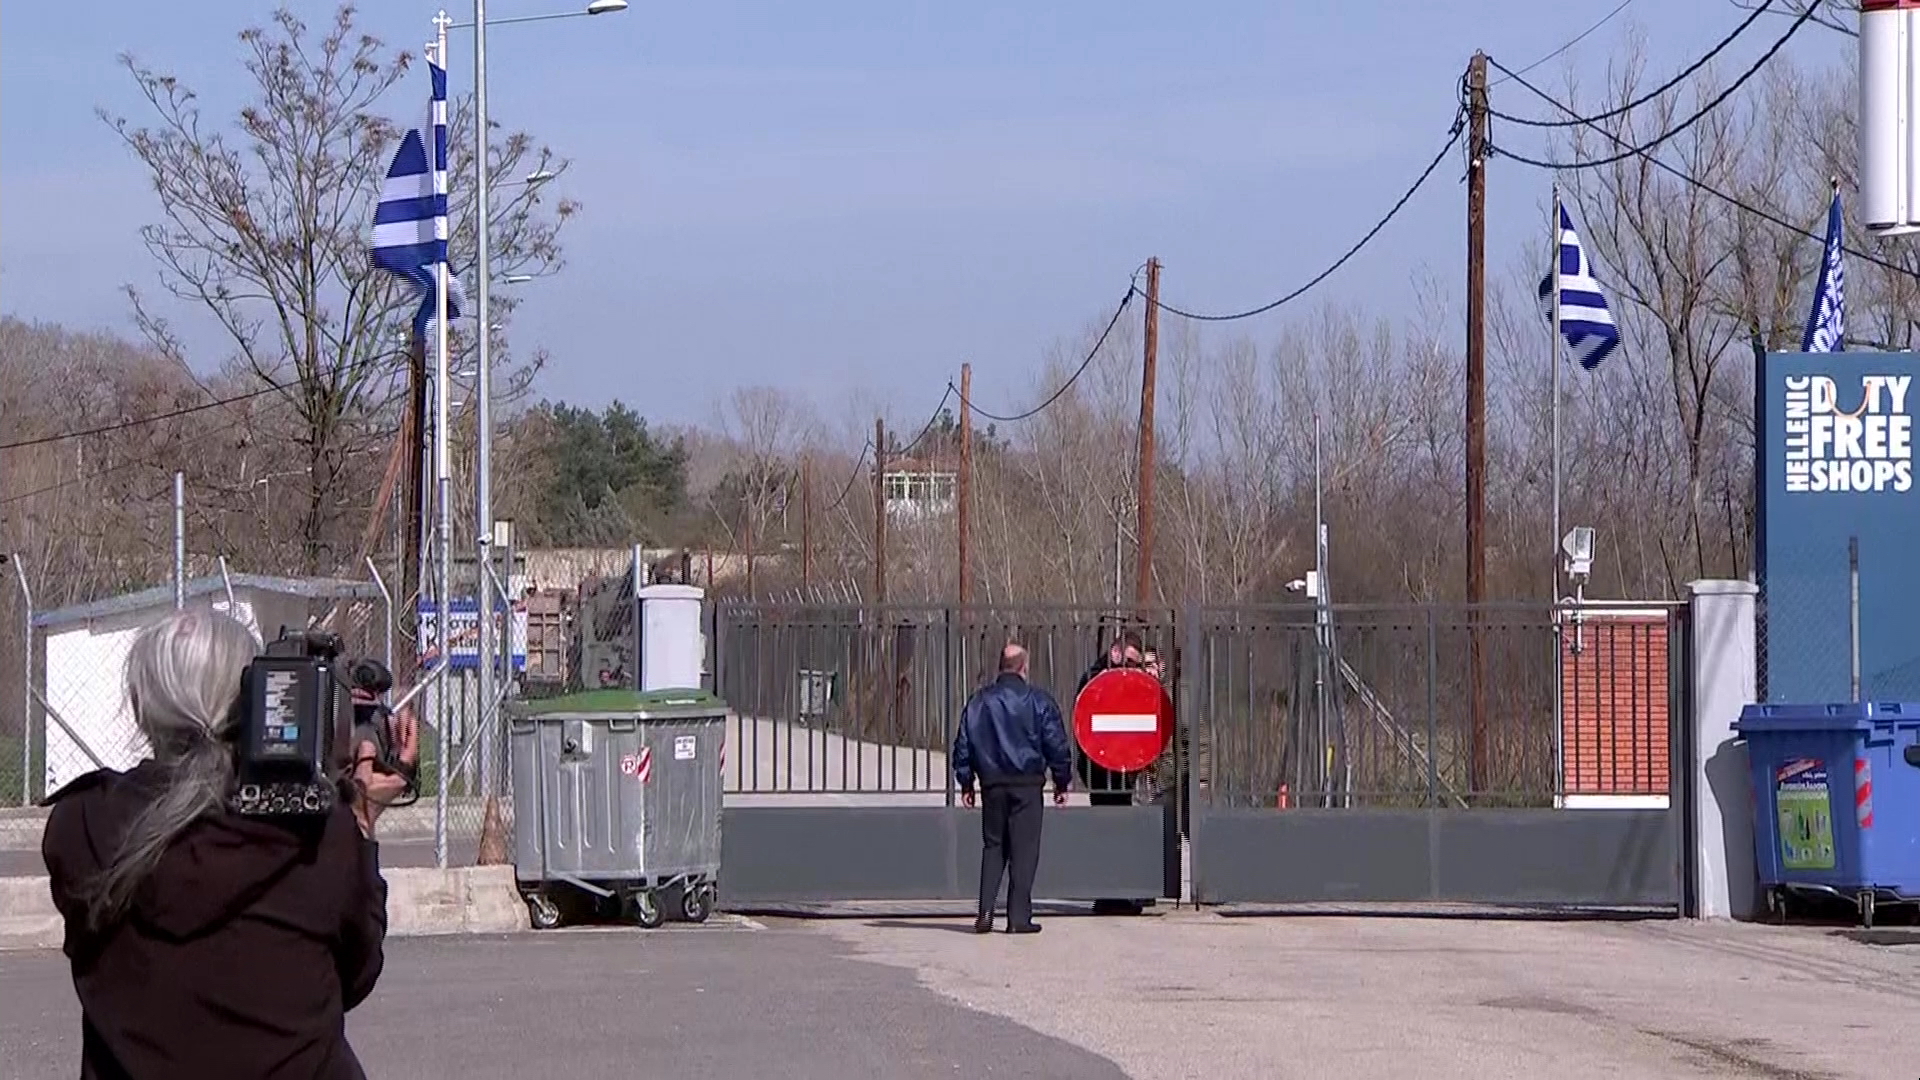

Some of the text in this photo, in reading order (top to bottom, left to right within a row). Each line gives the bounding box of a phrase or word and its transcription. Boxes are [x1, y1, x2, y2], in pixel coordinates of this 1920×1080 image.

[1811, 376, 1912, 416] DUTY
[1786, 376, 1809, 491] HELLENIC
[1811, 415, 1911, 459] FREE
[1810, 460, 1912, 492] SHOPS
